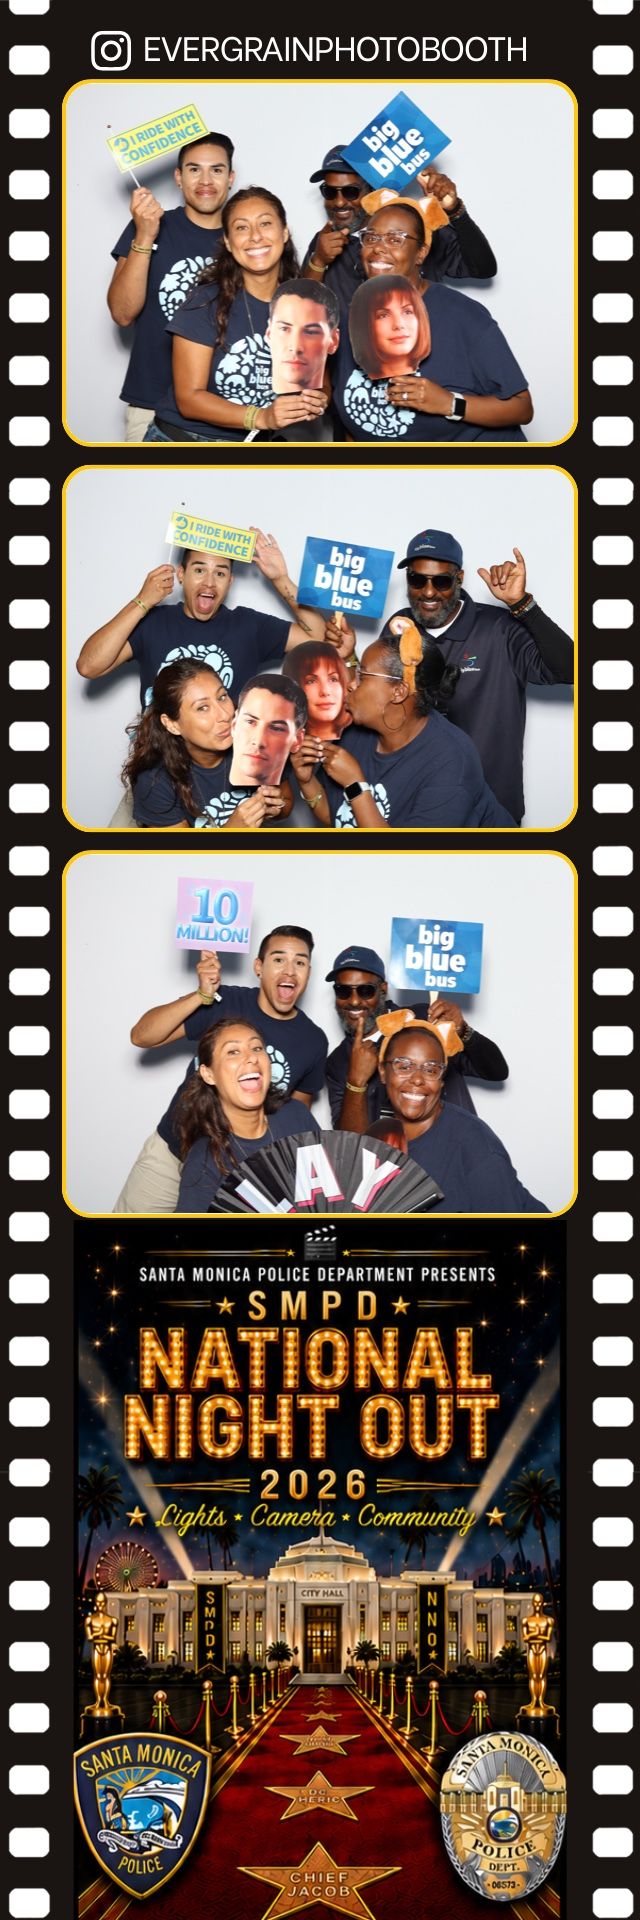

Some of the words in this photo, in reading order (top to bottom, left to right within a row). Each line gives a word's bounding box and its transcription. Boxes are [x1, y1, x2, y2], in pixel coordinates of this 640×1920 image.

[130, 135, 137, 145] I
[136, 123, 165, 142] RIDE
[163, 110, 195, 130] WITH
[361, 120, 400, 153] big
[121, 121, 202, 164] CONFIDENCE
[368, 128, 424, 178] blue
[400, 148, 431, 176] bus
[249, 373, 272, 385] blue
[255, 365, 270, 377] big
[174, 529, 249, 557] CONFIDENCE
[189, 521, 194, 531] I
[195, 523, 222, 538] RIDE
[222, 530, 252, 545] WITH
[329, 546, 366, 575] big
[313, 563, 374, 597] blue
[330, 591, 362, 611] bus
[191, 887, 239, 926] 10
[176, 923, 250, 944] MILLION!
[418, 924, 455, 951] big
[405, 943, 467, 973] blue
[425, 972, 457, 988] bus
[139, 1267, 186, 1282] SANTA
[192, 1267, 251, 1282] MONICA
[258, 1267, 310, 1282] POLICE
[317, 1267, 414, 1282] DEPARTMENT
[421, 1267, 496, 1282] PRESENTS
[248, 1290, 377, 1321] SMPD
[139, 1327, 492, 1390] NATIONAL
[124, 1394, 341, 1460] NIGHT
[359, 1394, 500, 1460] OUT
[260, 1469, 366, 1500] 2026
[155, 1503, 228, 1537] Lights
[250, 1503, 337, 1527] Camera
[358, 1503, 477, 1537] Community
[301, 1589, 321, 1597] CITY
[322, 1589, 344, 1597] HALL
[427, 1591, 438, 1647] NNO
[80, 1745, 133, 1778] SANTA
[137, 1744, 202, 1778] MONICA
[457, 1740, 496, 1778] SANTA
[500, 1737, 551, 1778] MONICA
[472, 1839, 536, 1859] POLICE
[117, 1856, 164, 1875] POLICE
[290, 1872, 348, 1883] CHIEF
[489, 1862, 520, 1871] DEPT.
[288, 1886, 350, 1897] JACOB
